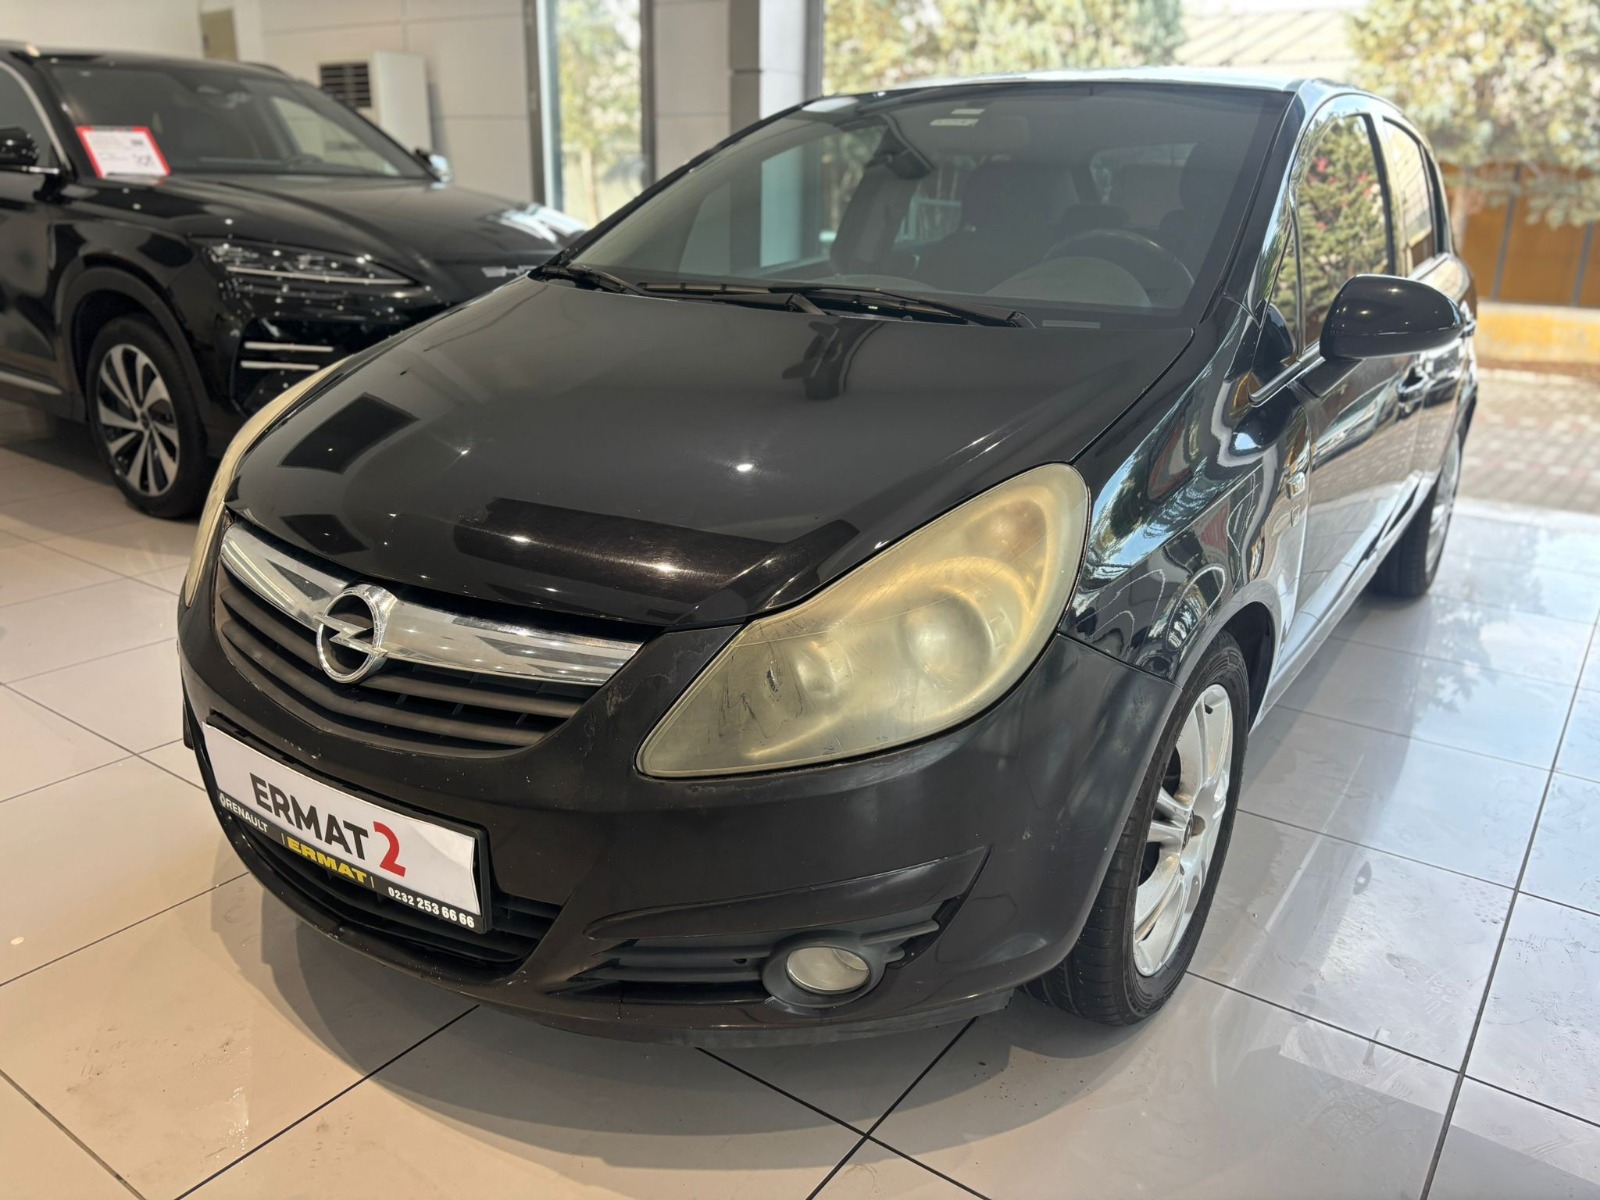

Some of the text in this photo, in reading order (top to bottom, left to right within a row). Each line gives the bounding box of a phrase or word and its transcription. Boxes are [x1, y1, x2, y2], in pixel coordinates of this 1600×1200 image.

[225, 798, 475, 929] RENAULT ERMAT 0232 253 66 66
